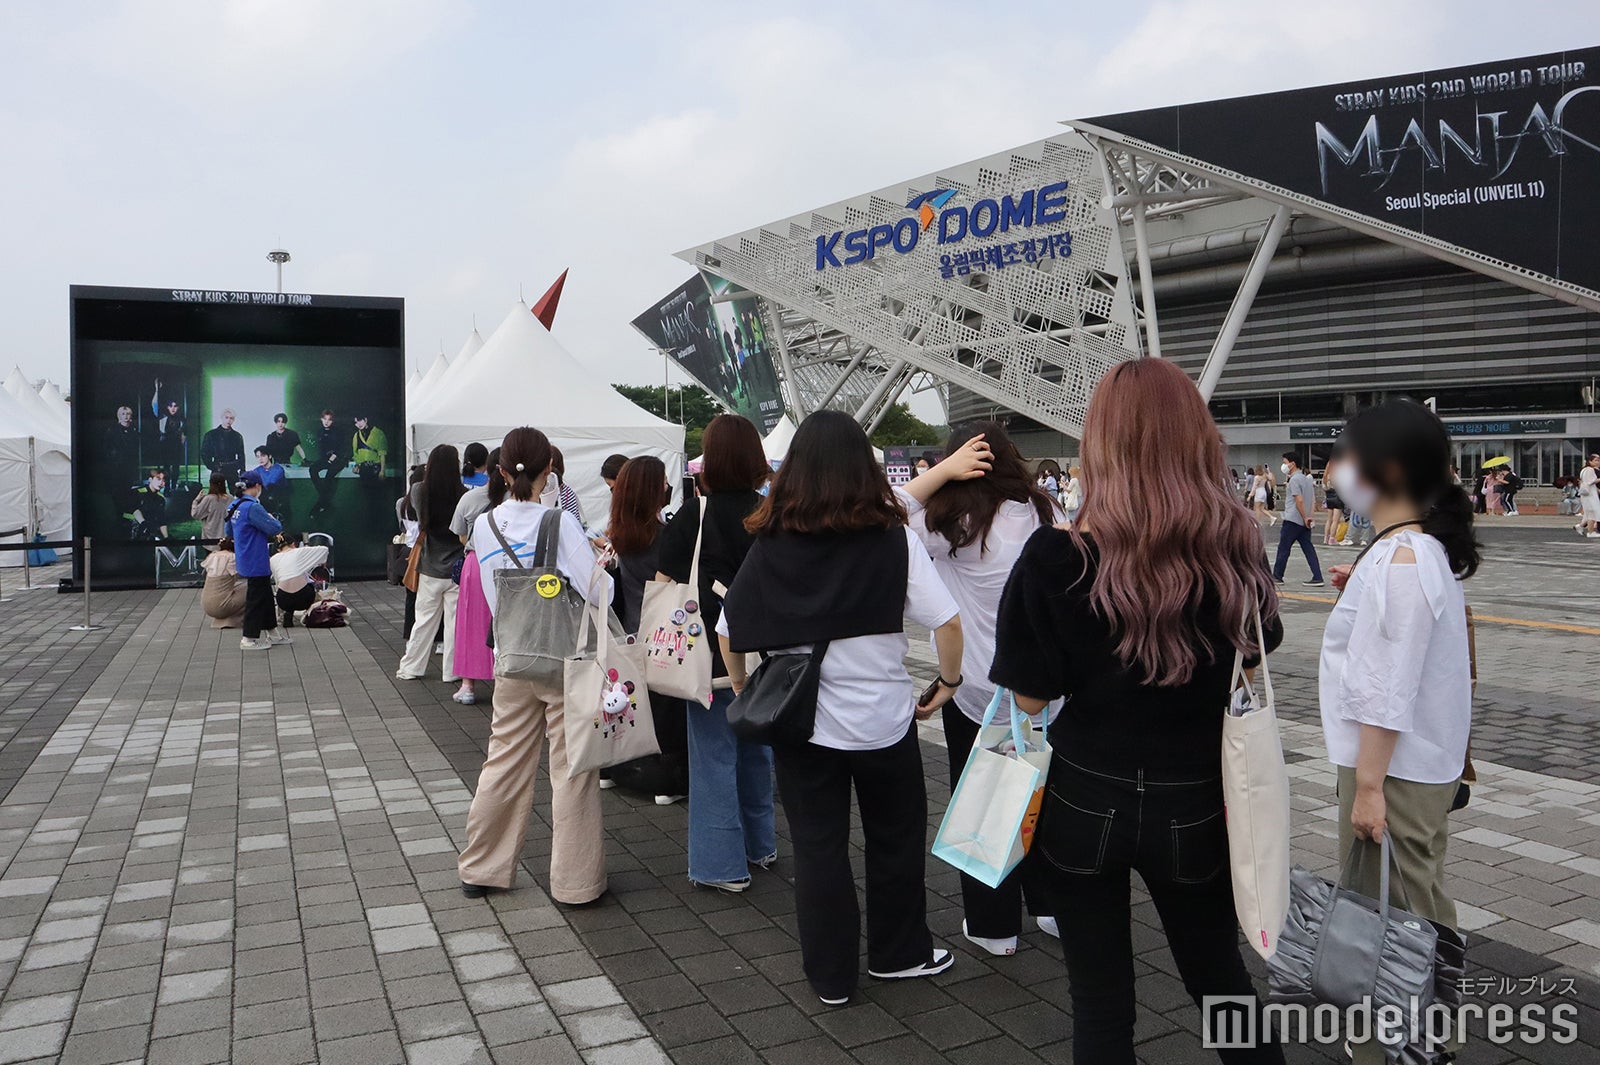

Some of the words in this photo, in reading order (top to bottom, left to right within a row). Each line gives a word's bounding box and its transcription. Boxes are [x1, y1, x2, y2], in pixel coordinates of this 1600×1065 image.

[1334, 88, 1384, 112] STRAY
[1389, 84, 1426, 106] KIDS
[1431, 78, 1466, 100] 2ND
[1470, 69, 1532, 95] WORLD
[1537, 61, 1586, 87] TOUR
[1385, 192, 1421, 212] Seoul
[1423, 186, 1471, 210] Special
[1474, 181, 1526, 205] (UNVEIL
[1527, 179, 1545, 200] 11)
[815, 217, 919, 271] KSPO
[937, 181, 1069, 245] DOME
[938, 231, 1073, 280] 올림픽체조경기장
[172, 290, 203, 303] STRAY
[205, 291, 228, 303] KIDS
[230, 292, 250, 304] 2ND
[253, 293, 285, 304] WORLD
[287, 294, 312, 305] TOUR
[1466, 423, 1482, 433] 입장
[1485, 422, 1510, 432] 게이트
